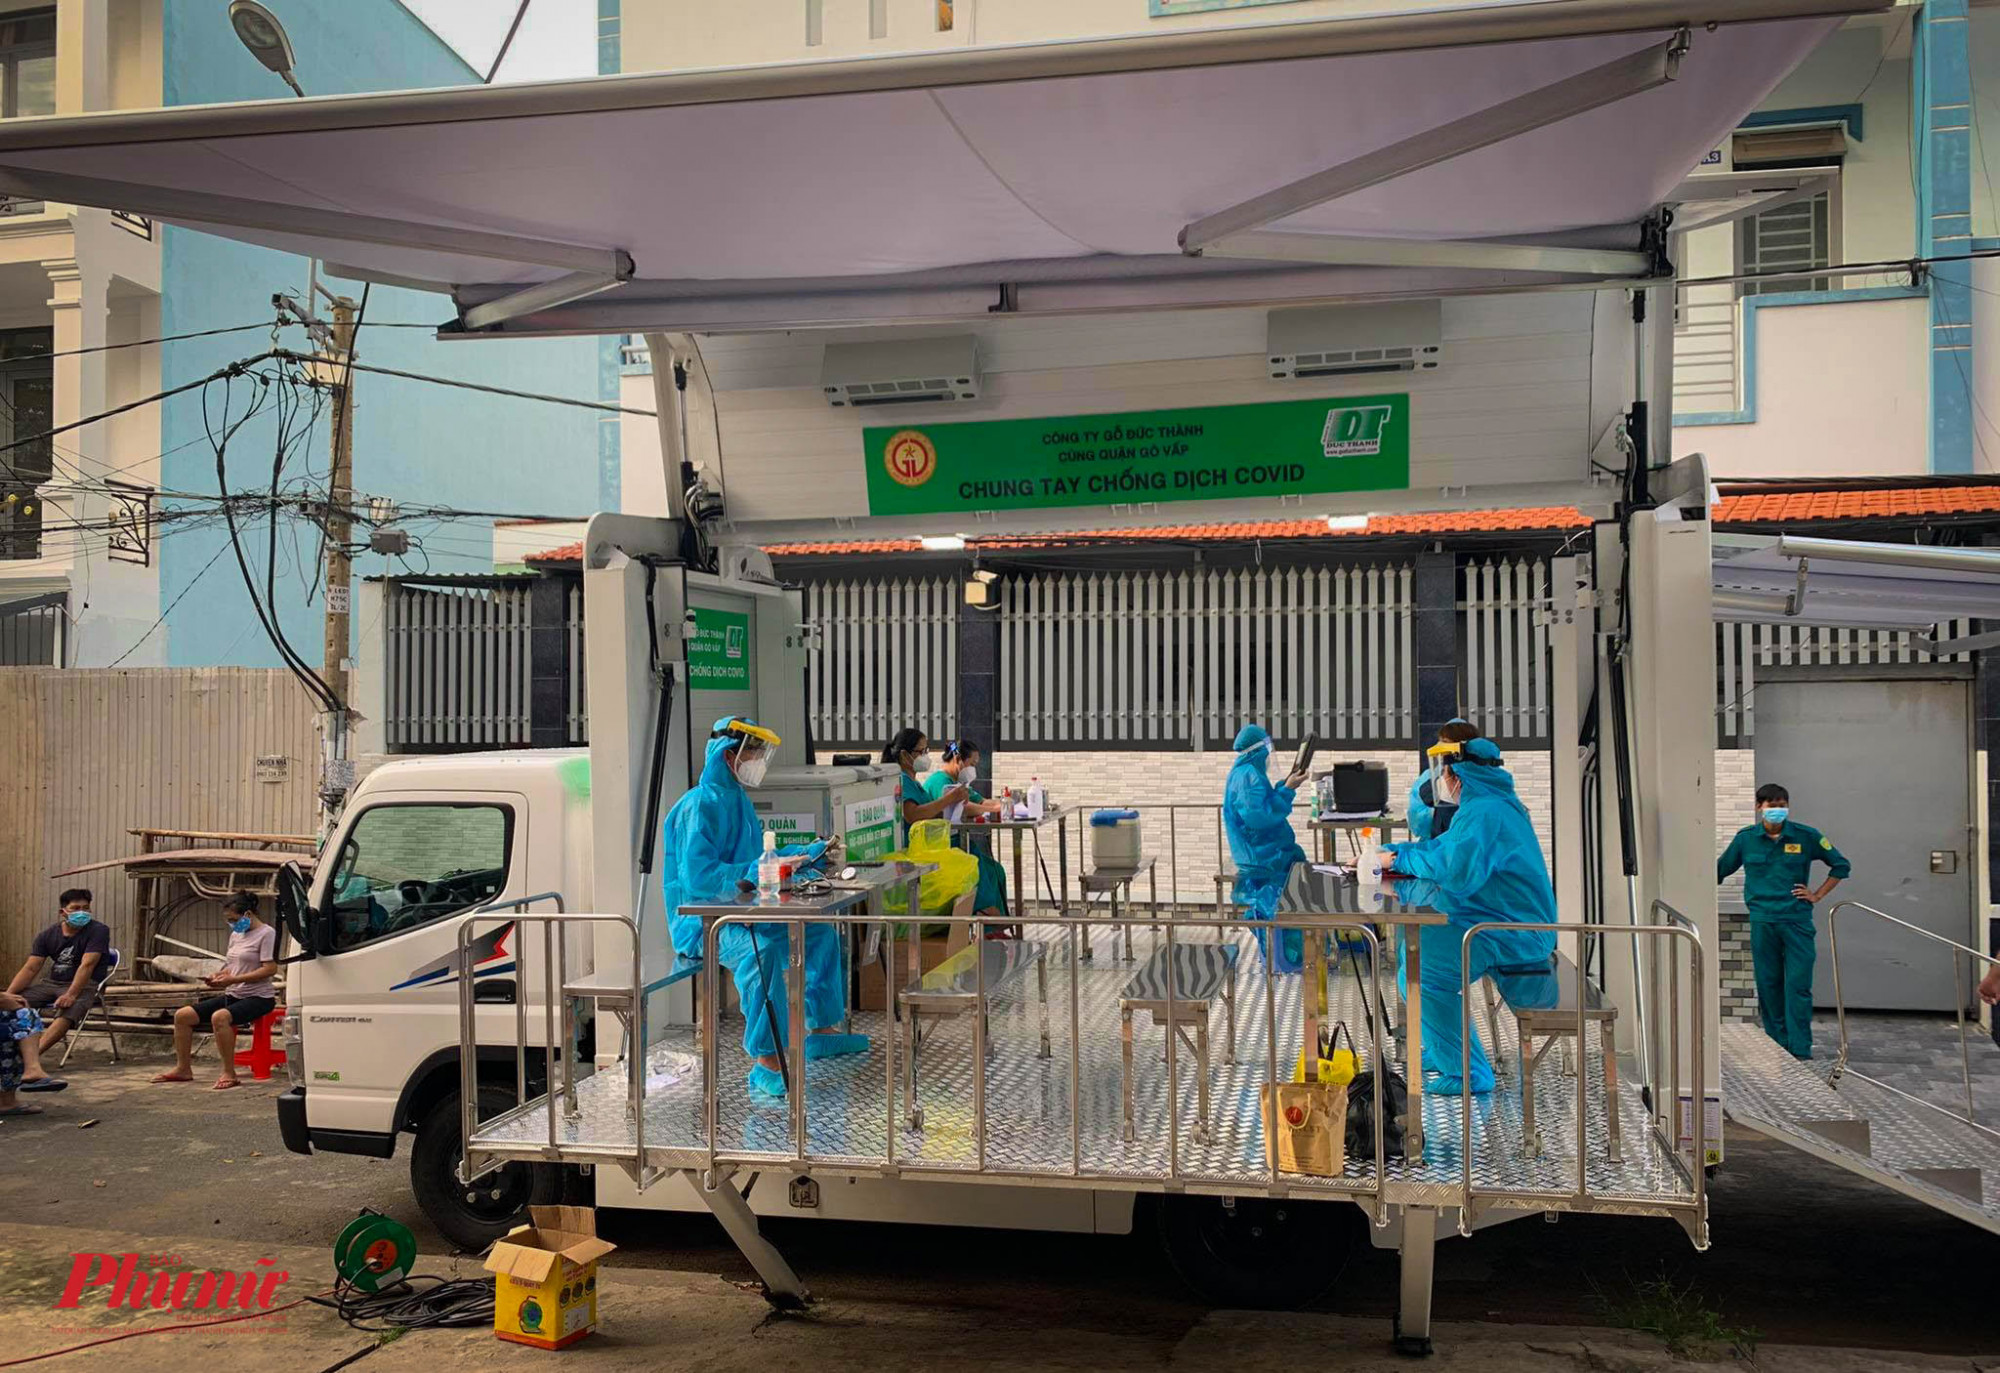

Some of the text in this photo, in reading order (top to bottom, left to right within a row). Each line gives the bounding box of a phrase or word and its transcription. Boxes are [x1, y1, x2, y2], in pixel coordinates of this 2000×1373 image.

[1042, 424, 1204, 445] CÔNG TY GỖ ĐỨC THÀNH
[1098, 447, 1136, 462] QUẬN
[1139, 444, 1160, 458] GÒ
[1163, 441, 1190, 457] VẤP
[958, 464, 1305, 500] CHUNG TAY CHỐNG DỊCH COVID
[768, 816, 797, 830] QUẢN
